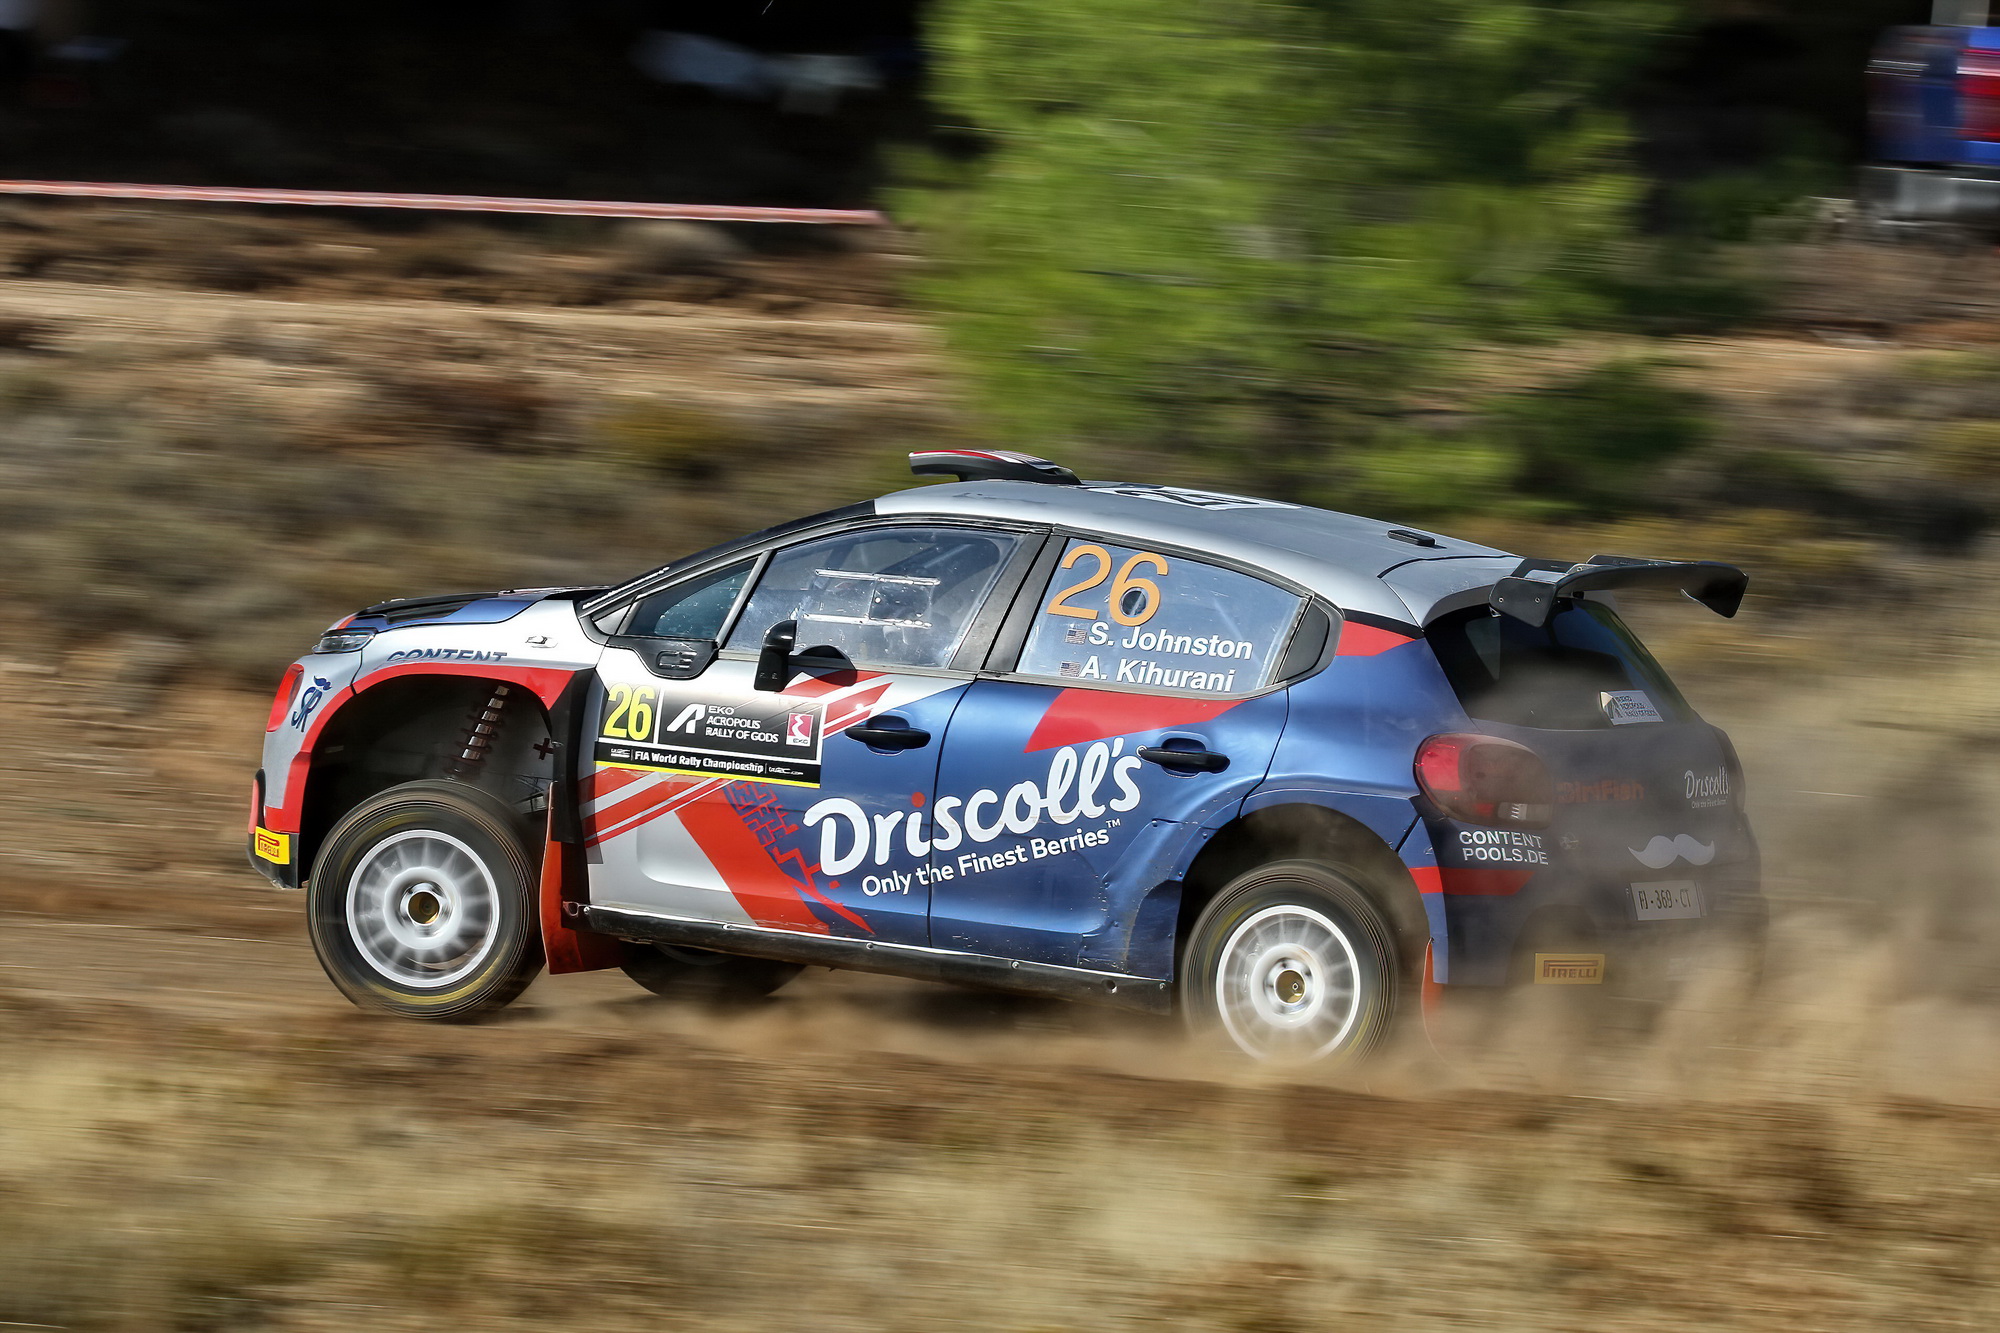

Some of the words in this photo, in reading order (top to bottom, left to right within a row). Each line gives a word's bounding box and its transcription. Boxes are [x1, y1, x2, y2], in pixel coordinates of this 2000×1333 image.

[1046, 544, 1169, 627] 26
[1088, 621, 1114, 647] S.
[1122, 626, 1253, 660] Johnston
[386, 648, 508, 661] CONTENT
[1078, 655, 1107, 681] A.
[1116, 658, 1236, 692] Kihurani
[603, 682, 655, 741] 26
[708, 705, 735, 715] EKO
[706, 716, 761, 729] ACROPOLIS
[705, 727, 734, 738] RALLY
[736, 730, 750, 740] OF
[751, 732, 779, 743] GODS
[634, 750, 650, 761] FIA
[651, 752, 677, 764] World
[679, 754, 701, 768] Rally
[702, 758, 764, 773] Championship
[803, 737, 1142, 876] Driscoll's
[1459, 830, 1542, 848] CONTENT
[1462, 847, 1549, 865] POOLS.DE
[862, 869, 913, 897] Only
[915, 863, 955, 886] the
[957, 844, 1028, 877] Finest
[1543, 960, 1600, 978] PIRELLI
